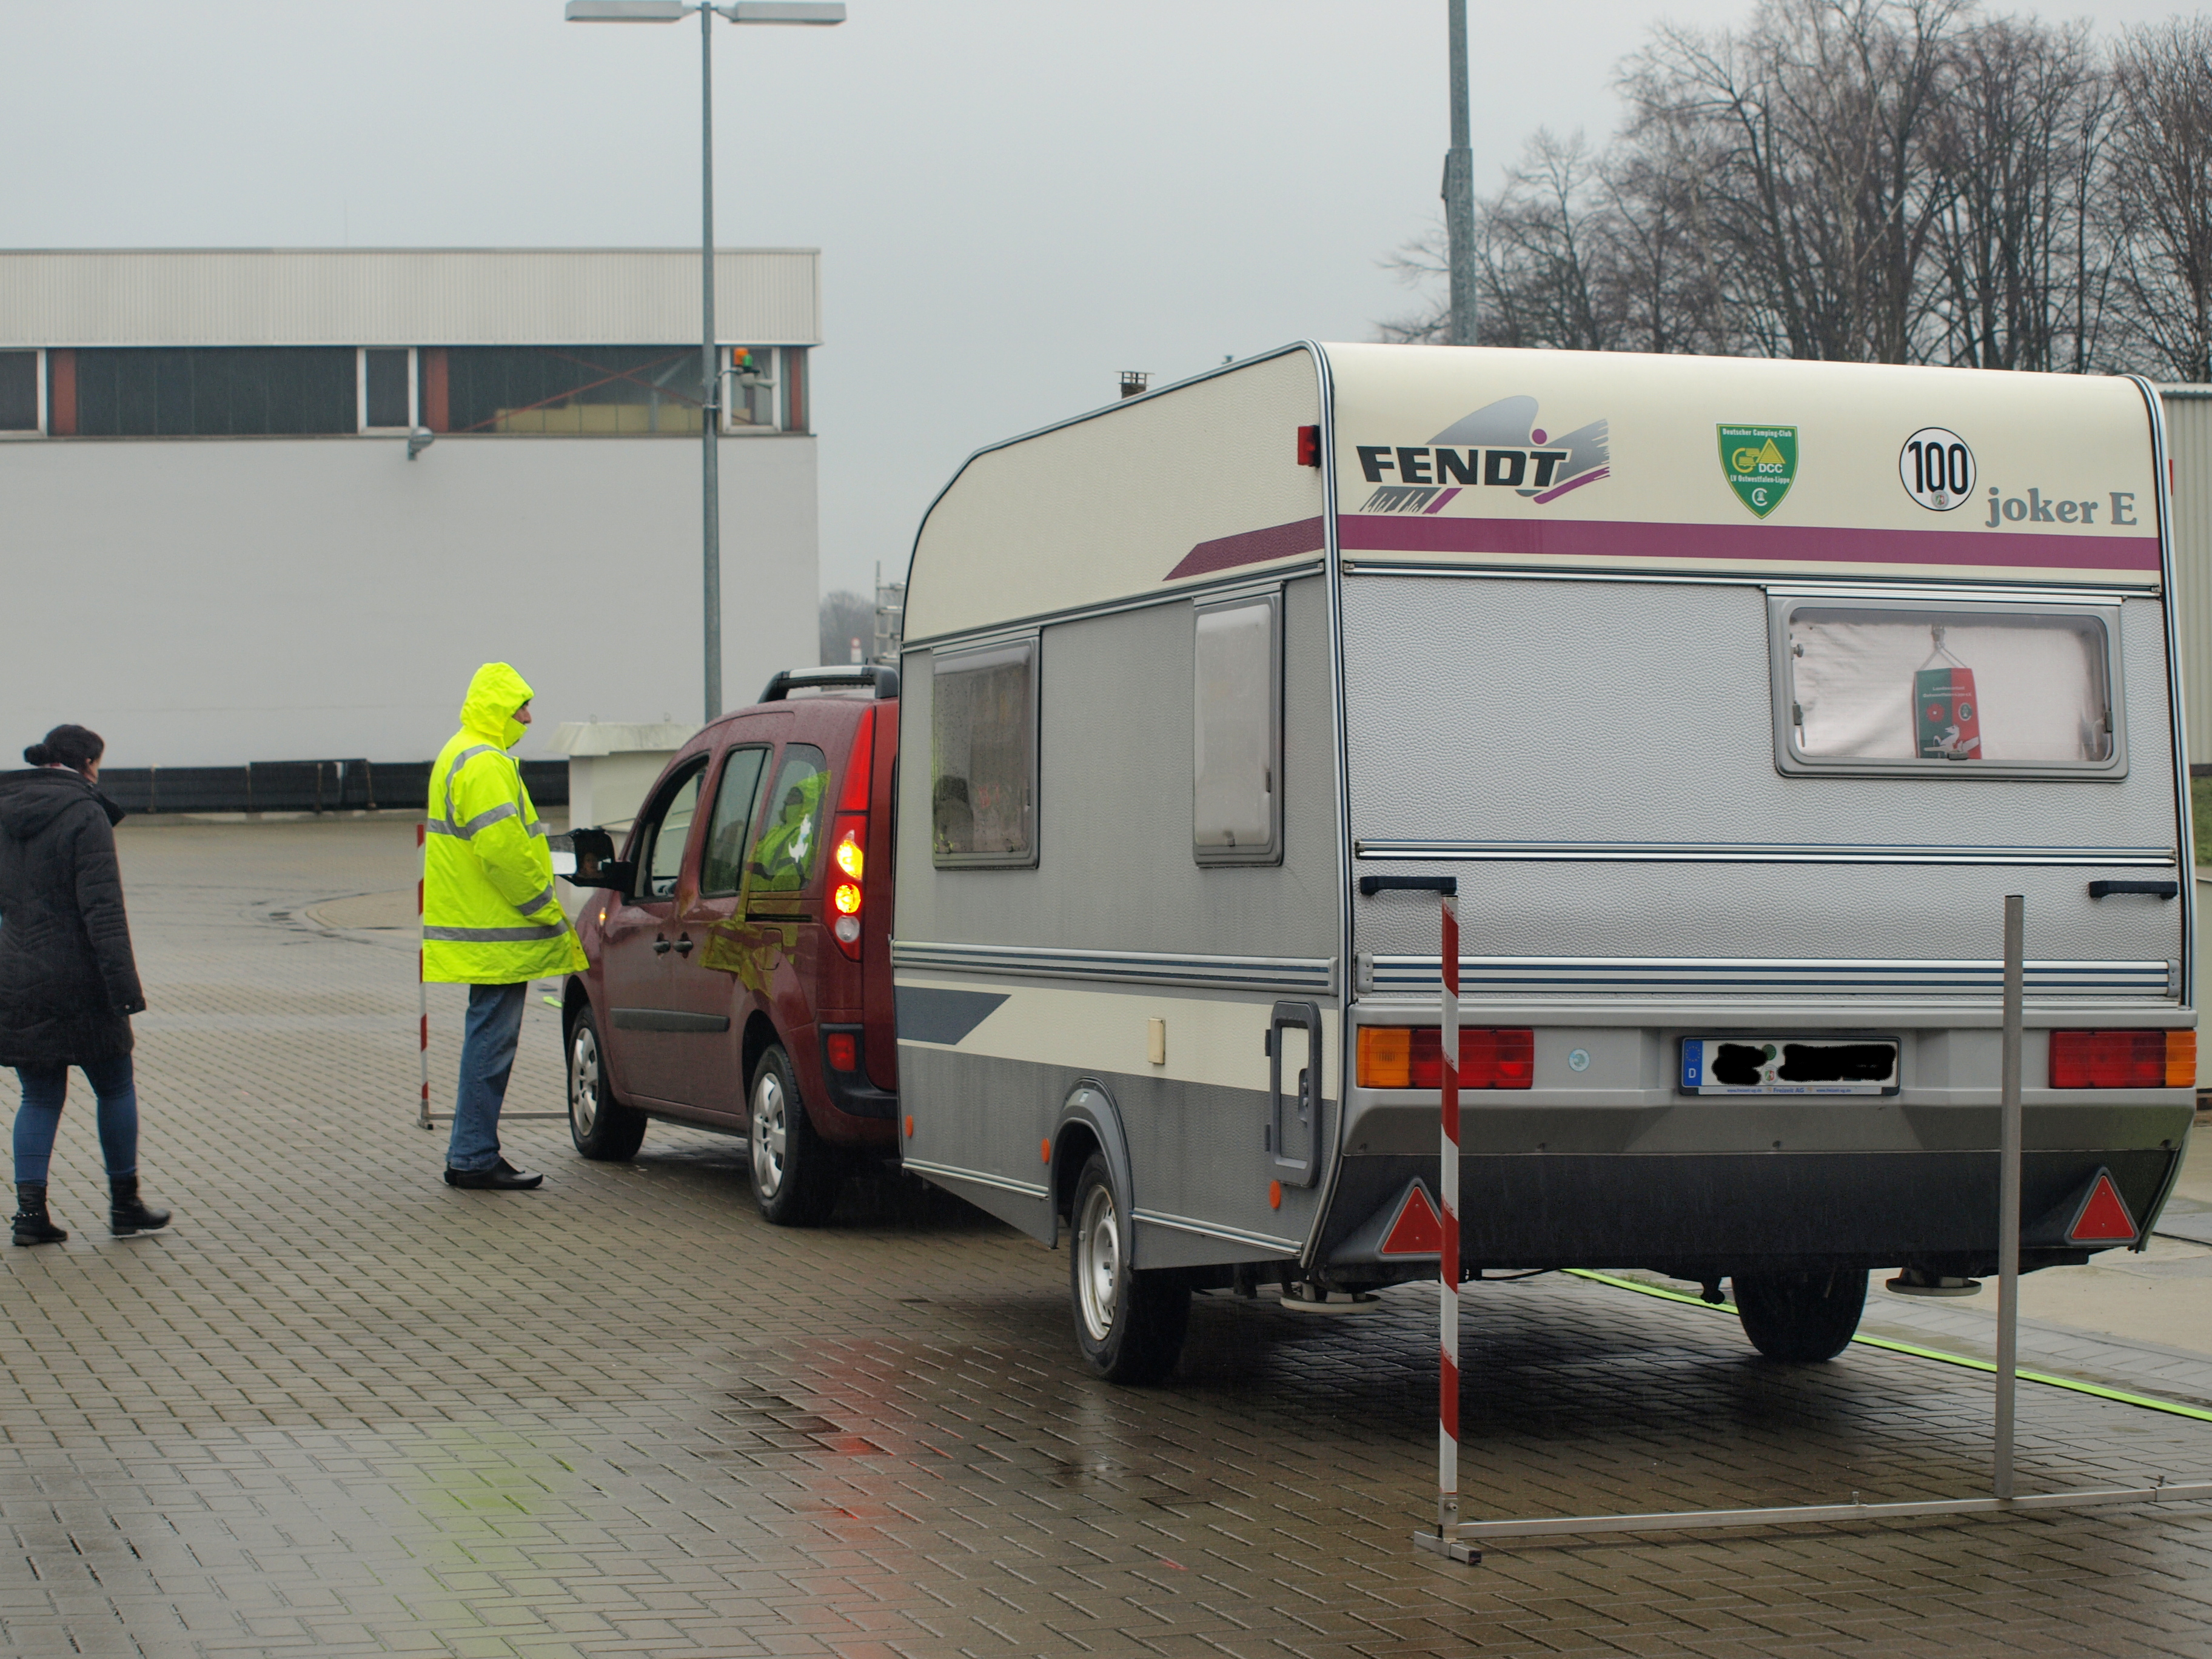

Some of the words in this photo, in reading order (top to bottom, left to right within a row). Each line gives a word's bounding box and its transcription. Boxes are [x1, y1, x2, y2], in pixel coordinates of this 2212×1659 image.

[1753, 429, 1792, 438] Camping-Club
[1356, 446, 1567, 487] FENDT
[1758, 463, 1783, 474] DCC
[1908, 441, 1968, 495] 100
[1738, 475, 1791, 484] Ostwestfalen-Lippe
[1985, 487, 2098, 528] joker
[2109, 492, 2137, 526] E
[1688, 1068, 1696, 1079] D
